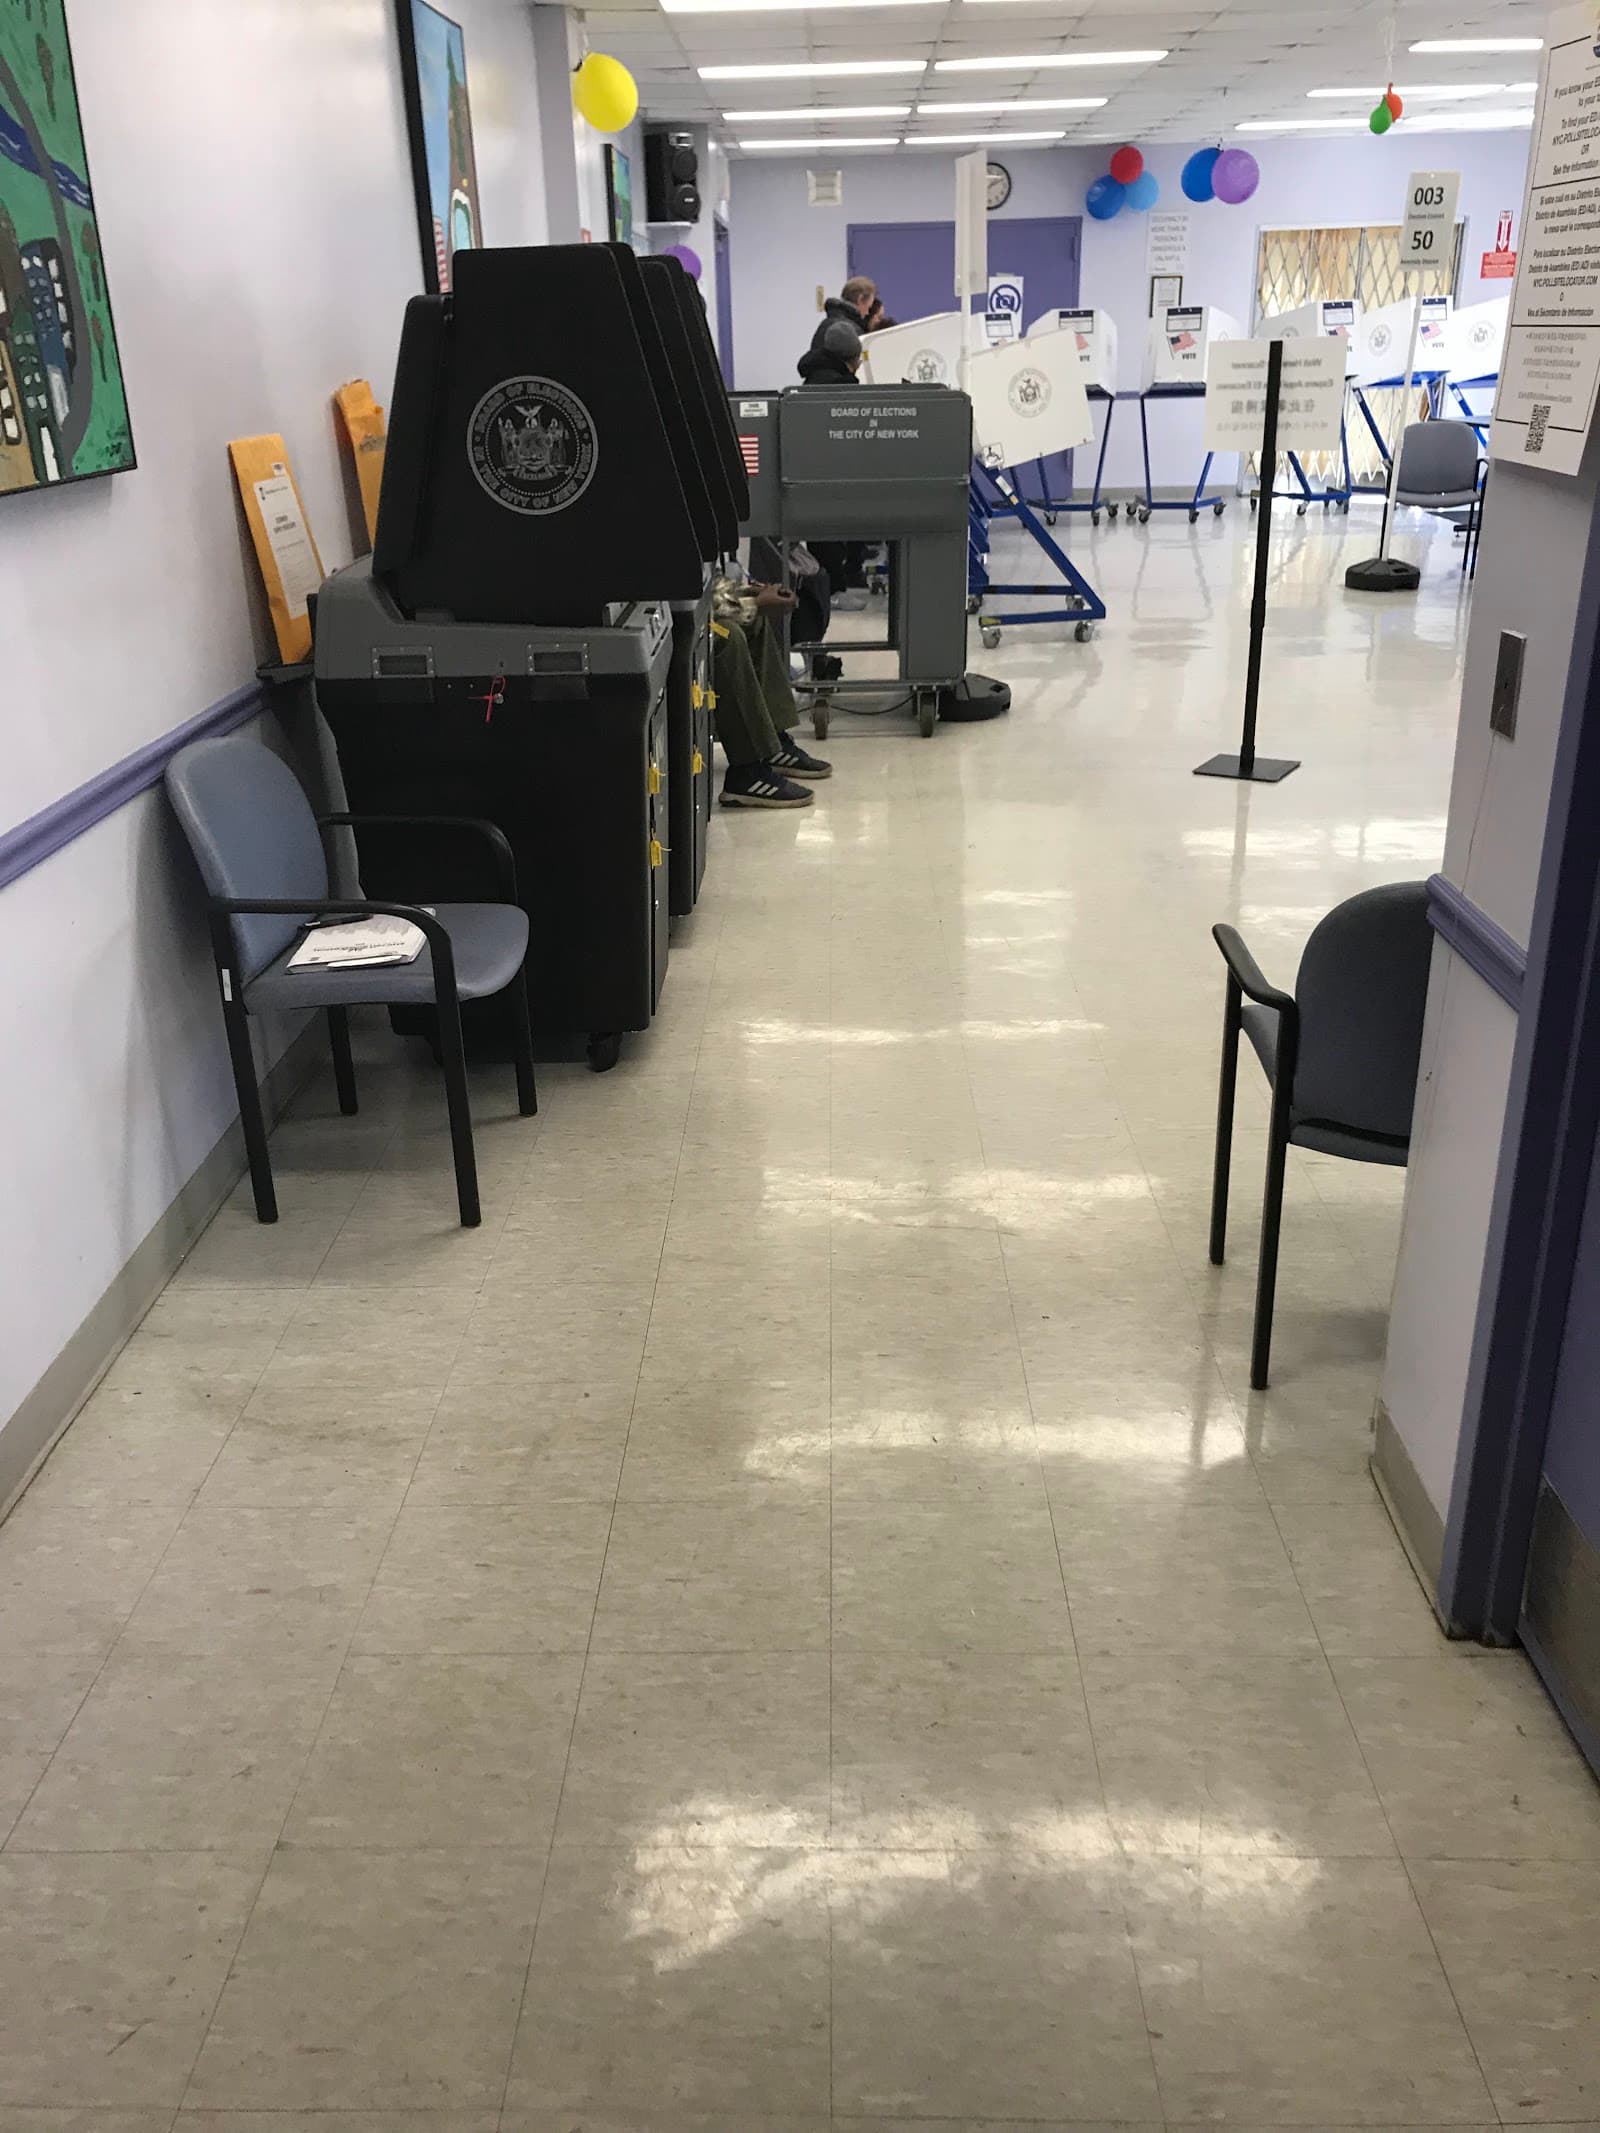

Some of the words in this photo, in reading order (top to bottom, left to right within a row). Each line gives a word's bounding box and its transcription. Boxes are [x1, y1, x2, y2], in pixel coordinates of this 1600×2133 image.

[1581, 144, 1590, 155] OR
[1553, 164, 1562, 175] See
[1562, 163, 1571, 174] the
[1413, 186, 1444, 206] 003
[1411, 230, 1434, 250] 50
[830, 407, 859, 417] BOARD
[860, 407, 872, 417] OF
[872, 407, 917, 417] ELECTIONS
[869, 419, 878, 428] IN
[829, 430, 844, 439] THE
[845, 430, 863, 439] CITY
[864, 430, 875, 439] OF
[877, 430, 896, 439] NEW
[896, 429, 919, 439] YORK
